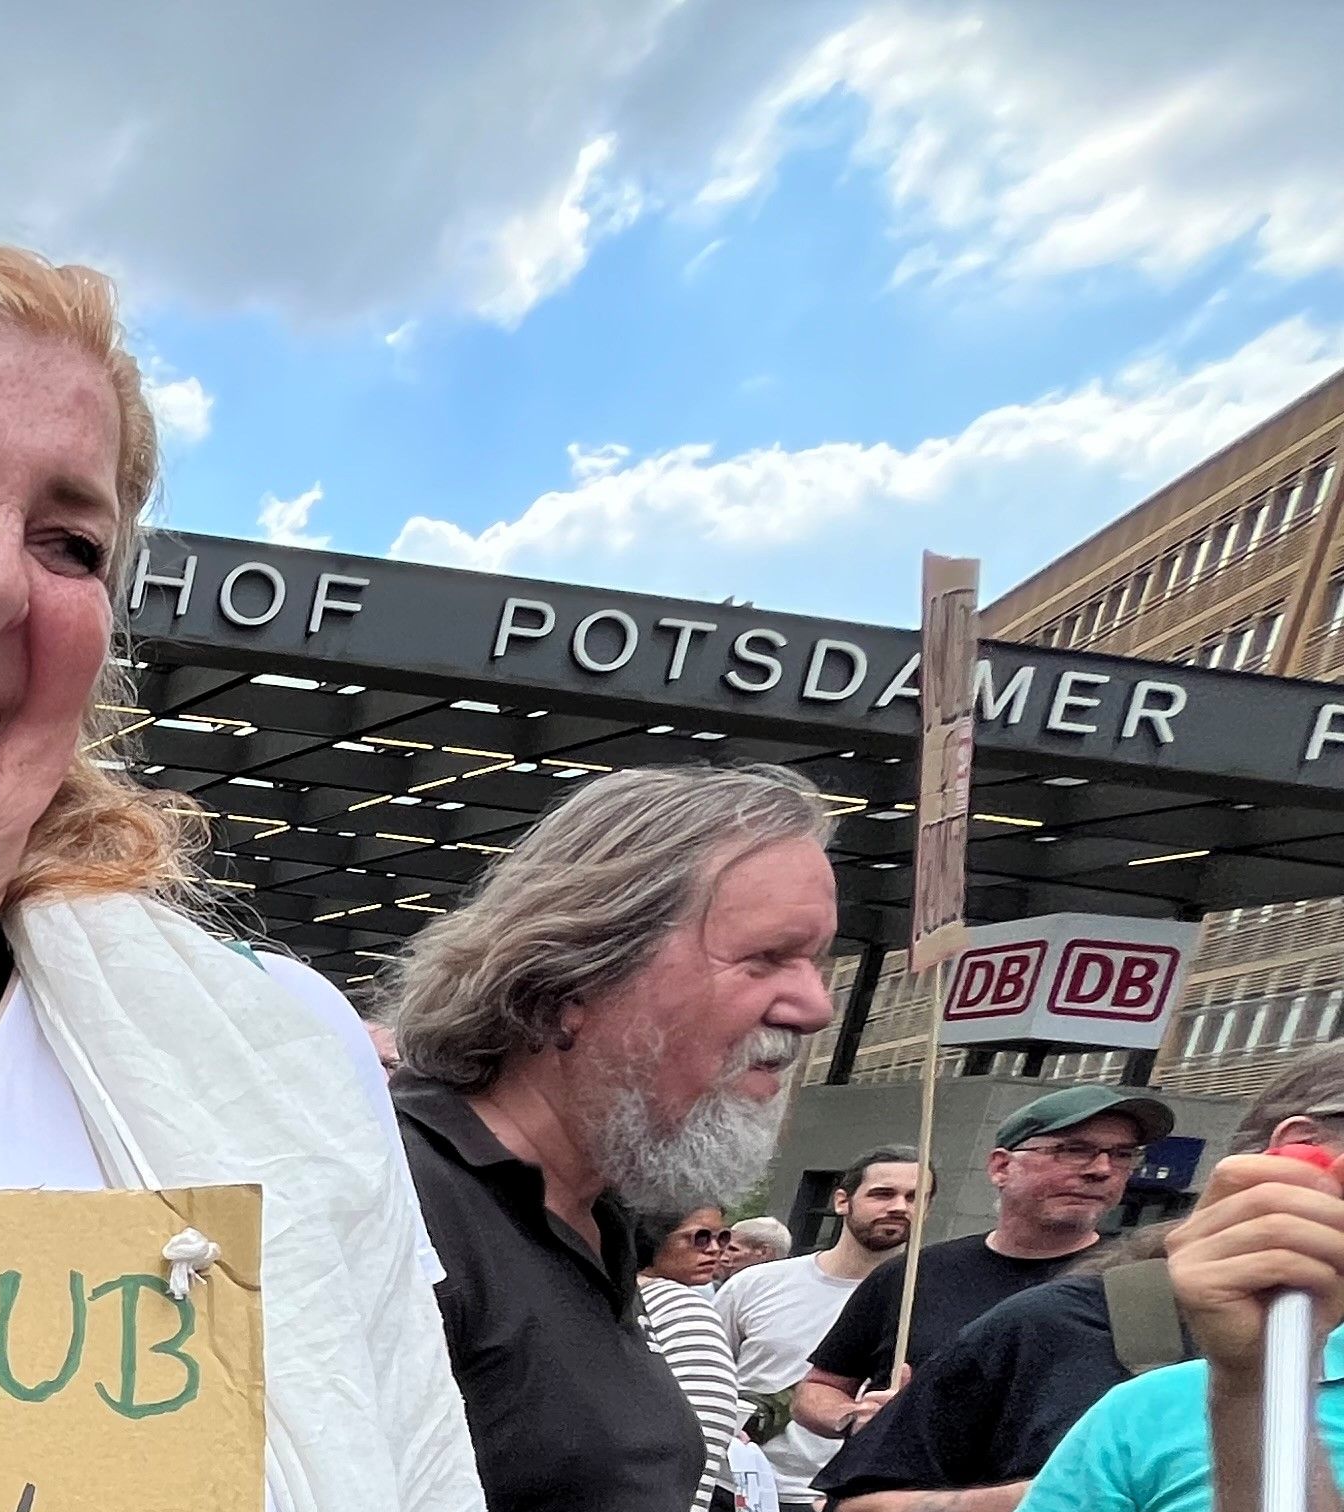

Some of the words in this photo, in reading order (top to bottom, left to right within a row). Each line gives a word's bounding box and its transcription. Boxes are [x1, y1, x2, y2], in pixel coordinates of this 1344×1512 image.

[129, 549, 371, 636] HOF
[956, 954, 1030, 1009] DB
[1064, 953, 1158, 1008] DB
